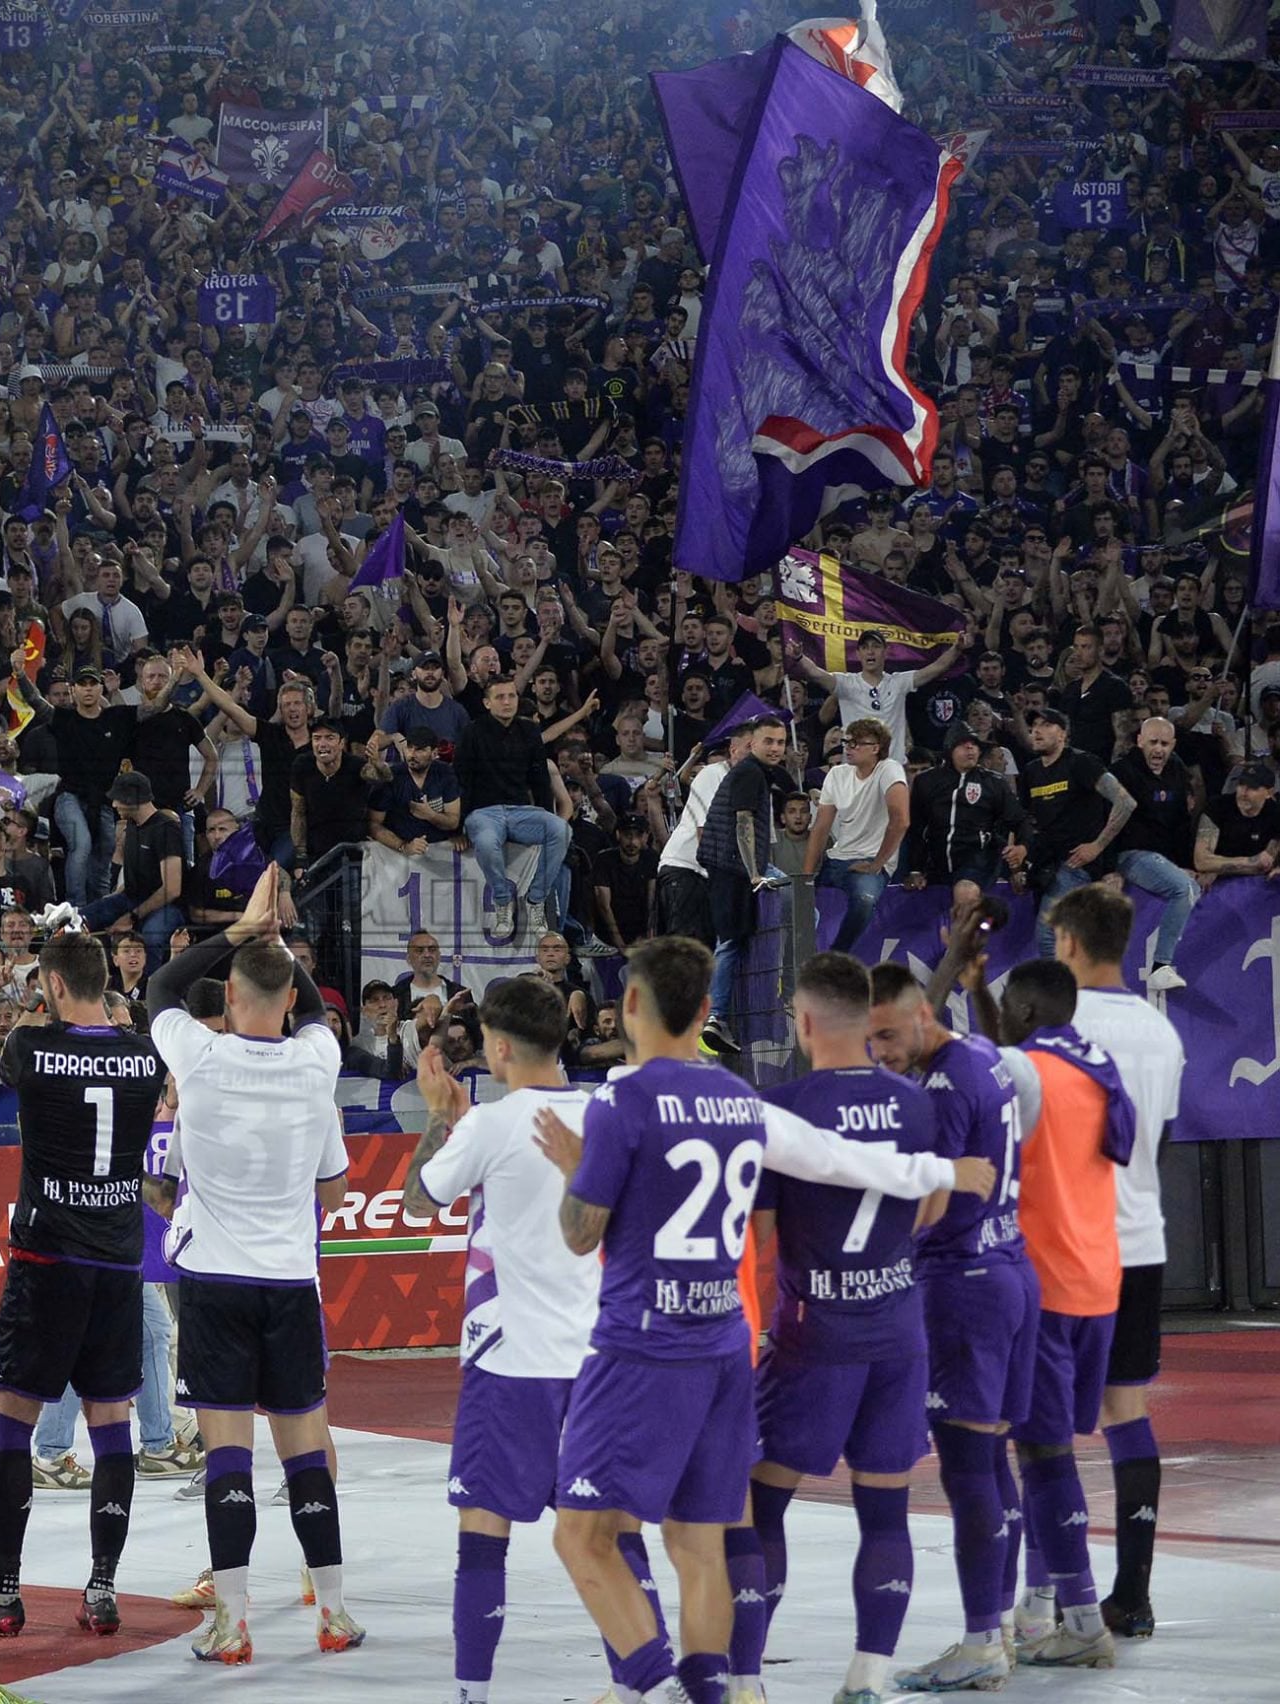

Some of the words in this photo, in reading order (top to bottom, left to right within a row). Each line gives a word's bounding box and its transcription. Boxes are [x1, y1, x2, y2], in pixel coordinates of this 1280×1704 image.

[4, 25, 31, 47] 13
[1073, 182, 1121, 196] ASTORI
[1080, 200, 1112, 224] 13
[33, 1050, 157, 1078] TERRACCIANO
[656, 1094, 693, 1124] M.
[835, 1096, 902, 1132] JOVIĆ
[84, 1087, 114, 1176] 1
[68, 1178, 139, 1194] HOLDING
[654, 1138, 764, 1261] 28
